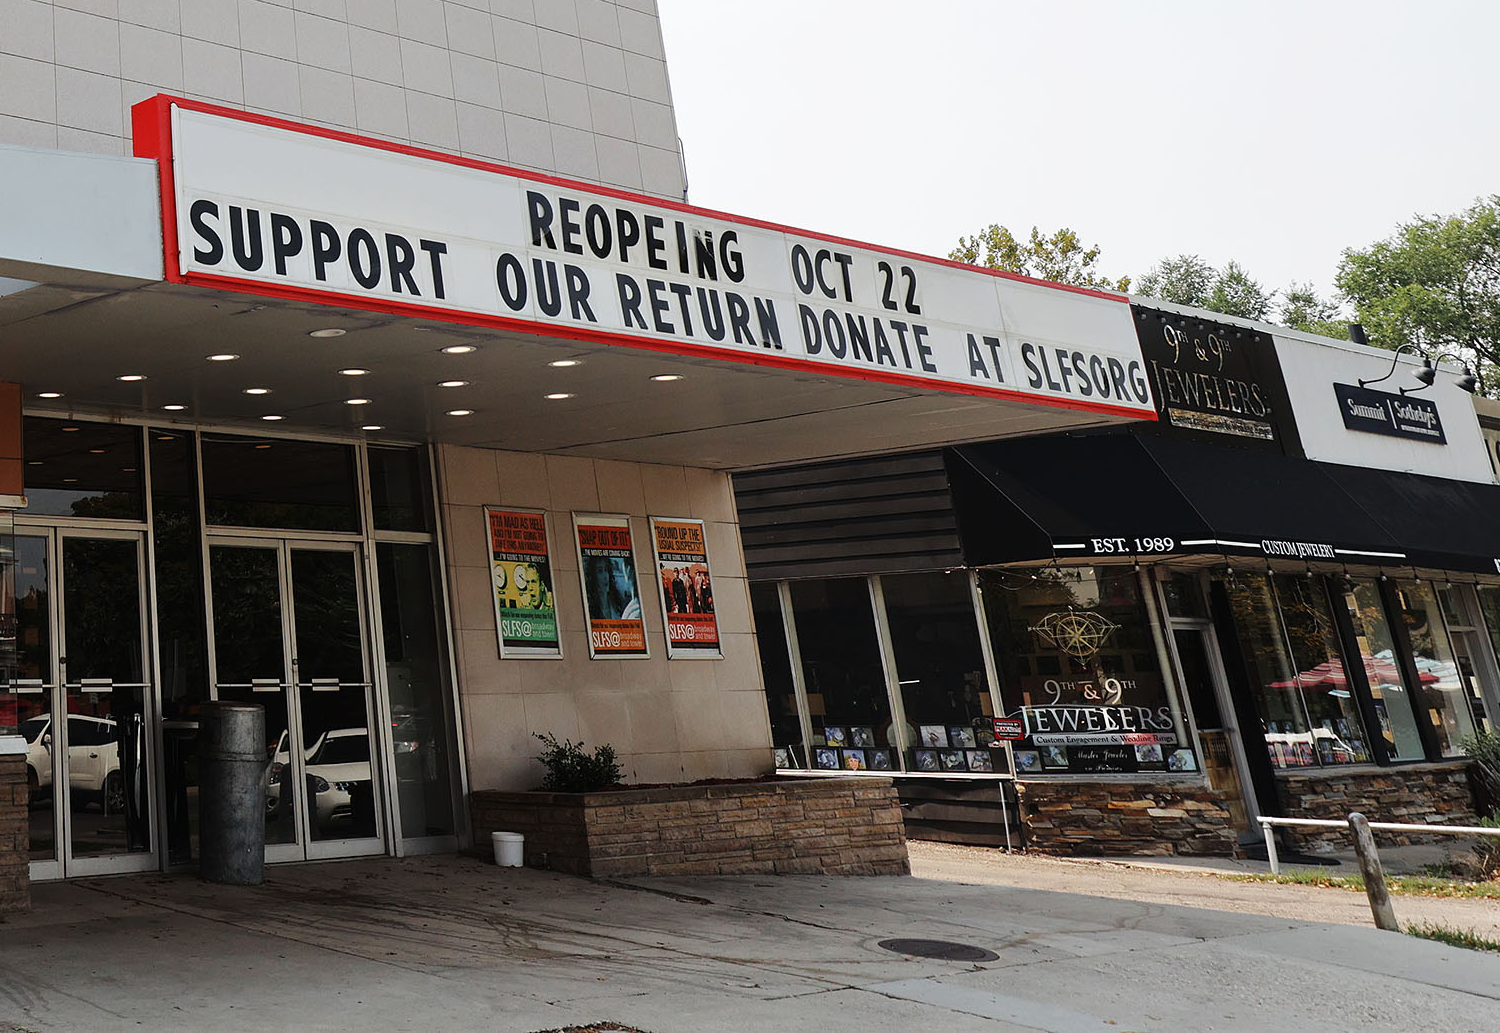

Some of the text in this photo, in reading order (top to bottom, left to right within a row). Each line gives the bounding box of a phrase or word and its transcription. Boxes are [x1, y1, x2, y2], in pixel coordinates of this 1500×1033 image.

[526, 190, 921, 315] REOPEING OCT 22
[190, 199, 1149, 405] SUPPORT OUR RETURN DONATE AT SLFSORG
[1163, 324, 1232, 372] 9TH & 9TH
[1150, 360, 1266, 417] JEWELERS
[1347, 398, 1437, 429] Summit Sotheby's
[679, 528, 688, 540] UP
[688, 528, 700, 542] THE
[1090, 536, 1175, 554] EST. 1989
[1261, 539, 1336, 559] CUSTOM JEWELERY
[502, 620, 532, 637] SLFS@
[592, 631, 620, 647] SLFS@
[669, 623, 695, 640] SLFS@
[1043, 678, 1137, 706] 9TH & 9TH
[1018, 705, 1175, 739] JEWELERS
[1066, 735, 1109, 744] Engagement
[1110, 735, 1118, 743] &
[1153, 735, 1174, 744] Rings
